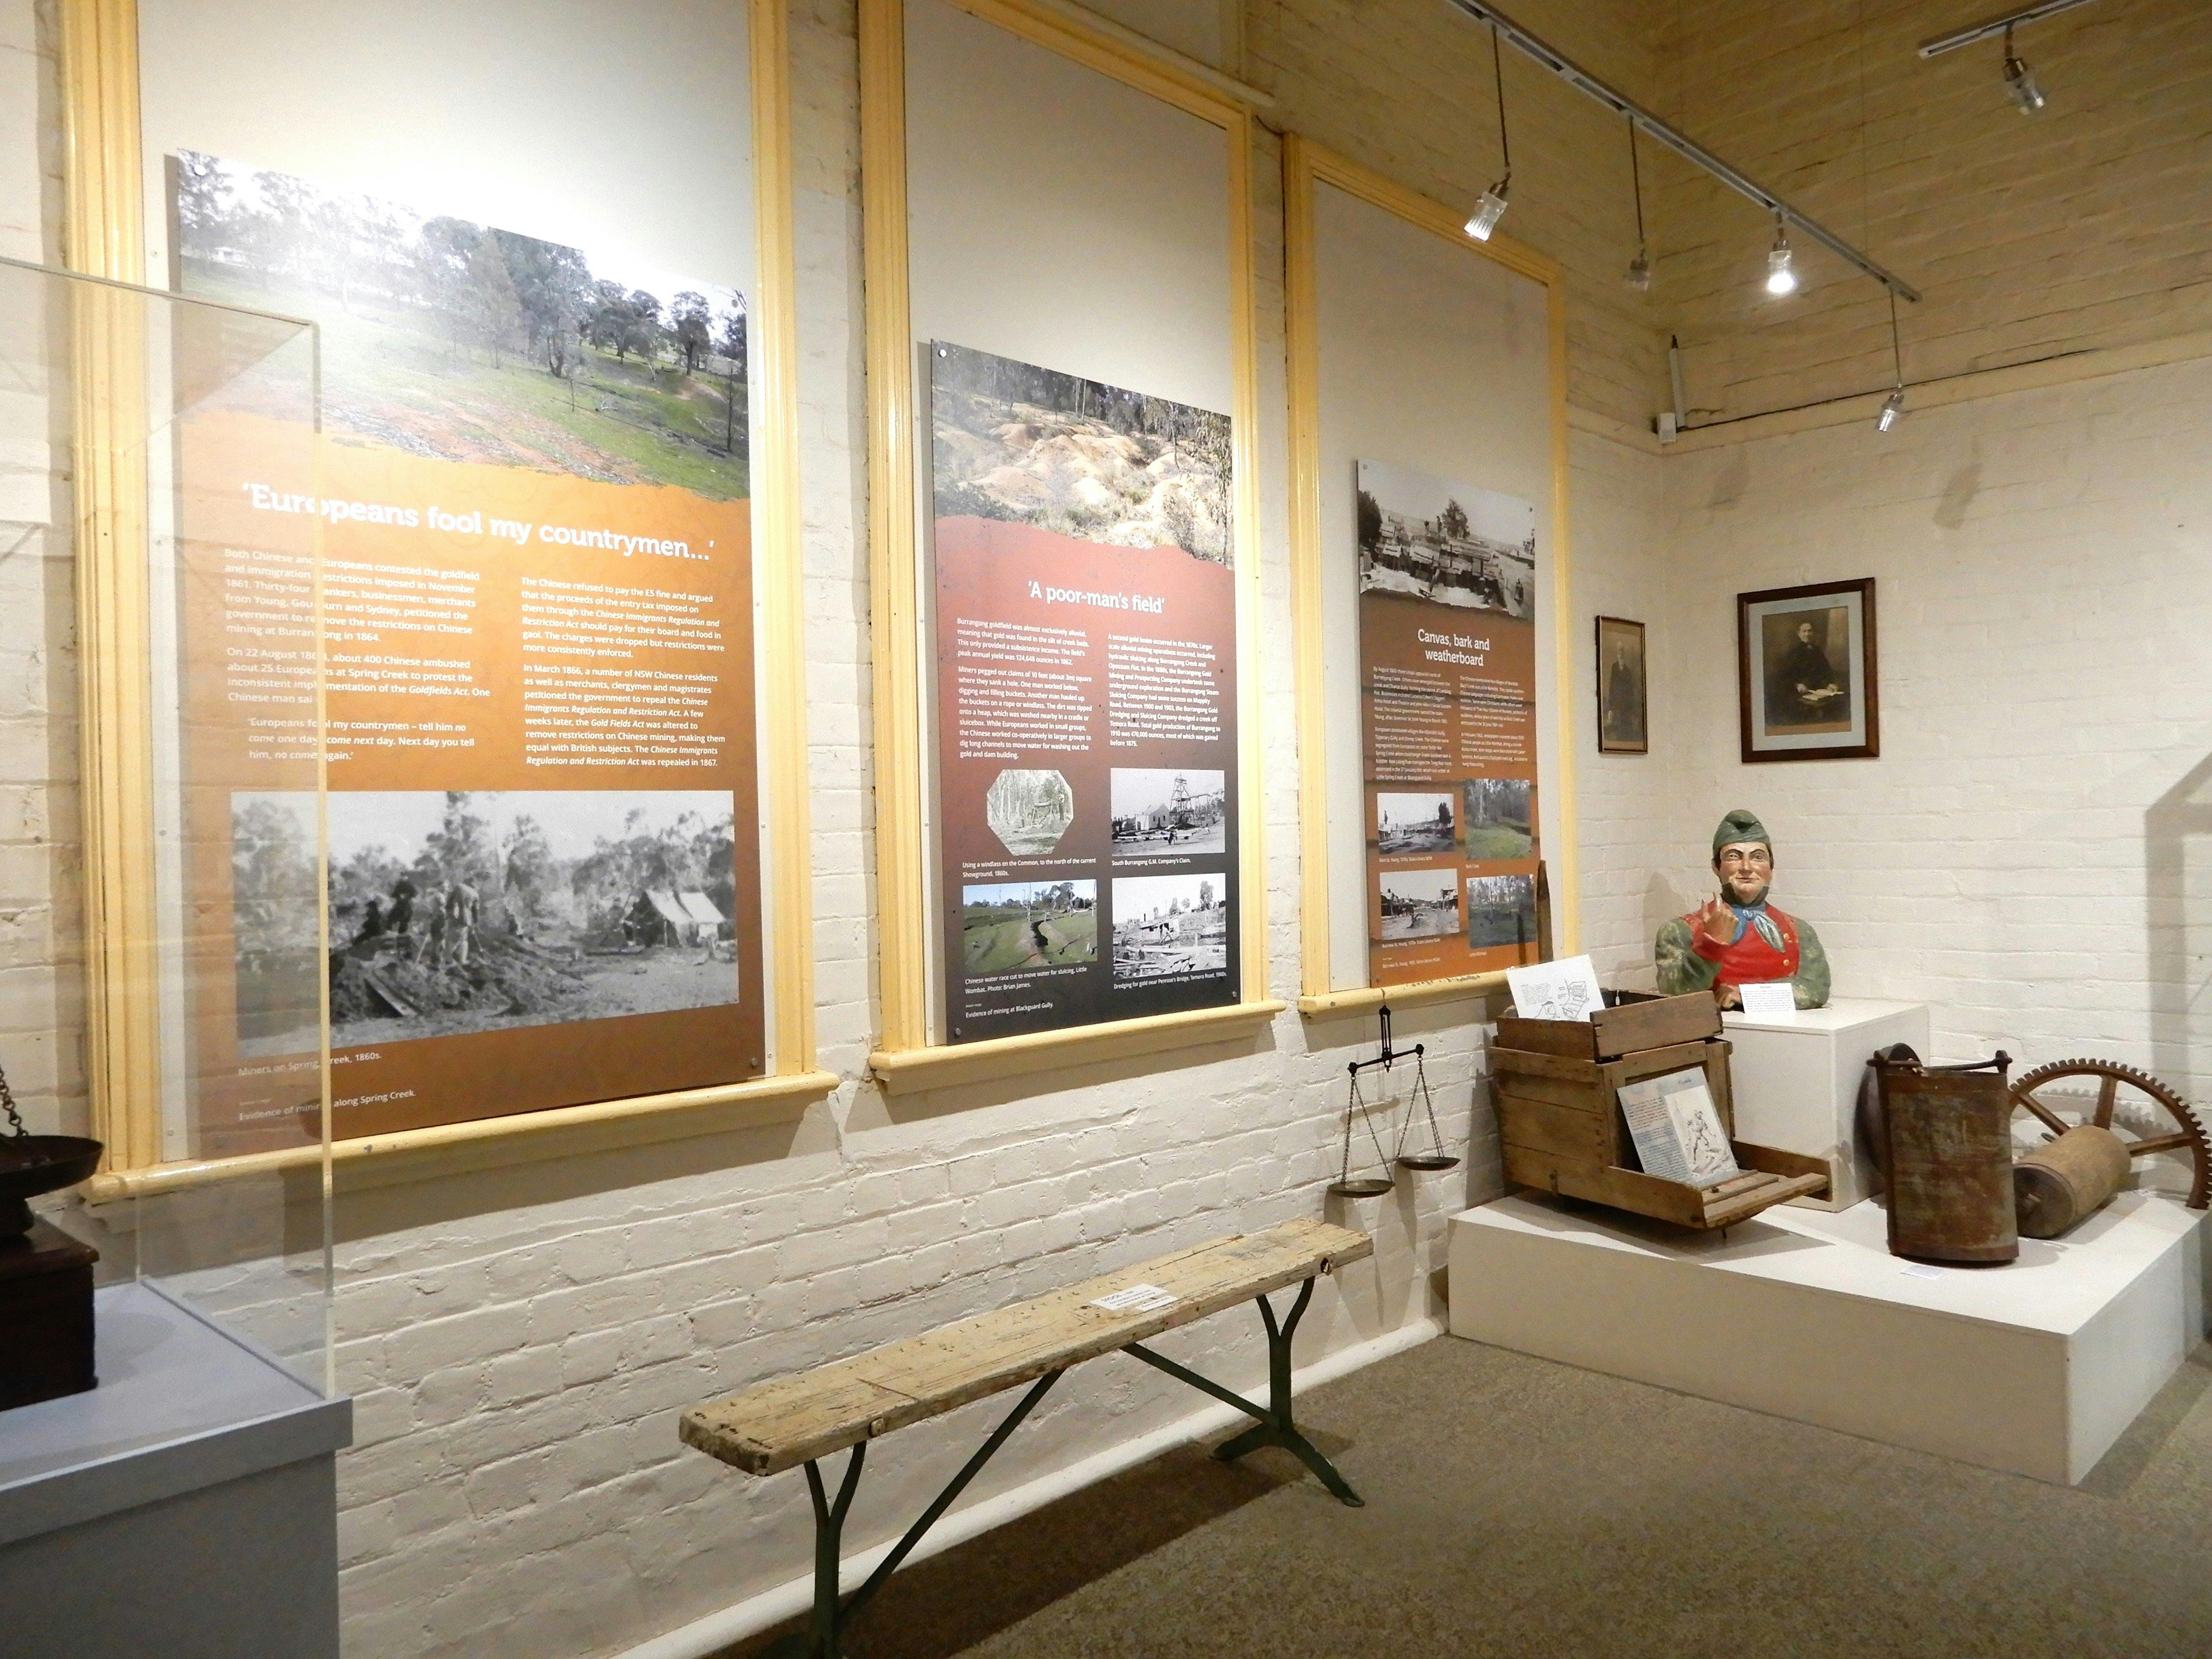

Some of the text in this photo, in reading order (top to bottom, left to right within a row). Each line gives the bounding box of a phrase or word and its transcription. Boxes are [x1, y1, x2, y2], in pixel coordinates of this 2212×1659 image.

[428, 506, 482, 535] fool
[492, 520, 532, 544] my
[540, 525, 714, 560] countrymen...'
[1028, 581, 1164, 614] 'A poor-man's field'
[1418, 629, 1490, 651] Canvas, bark and
[547, 646, 596, 657] consistently
[597, 648, 633, 658] enforced.
[1425, 649, 1483, 667] weatherboard
[534, 665, 560, 673] March
[562, 666, 583, 675] 1866,
[592, 669, 623, 677] number
[634, 670, 653, 678] NSW
[654, 671, 683, 680] Chinese
[685, 674, 718, 682] residents
[565, 680, 610, 690] merchants,
[611, 682, 652, 692] clergymen
[669, 686, 712, 694] magistrates
[524, 691, 567, 699] petitioned
[568, 693, 583, 701] the
[583, 694, 631, 702] government
[642, 696, 666, 705] repeal
[682, 697, 708, 705] Chinese
[553, 718, 573, 727] later,
[575, 718, 589, 726] the
[610, 719, 631, 728] Fields
[662, 721, 689, 729] altered
[969, 740, 981, 748] long
[1051, 743, 1071, 751] washing
[526, 756, 568, 766] Regulation
[658, 759, 690, 767] repealed
